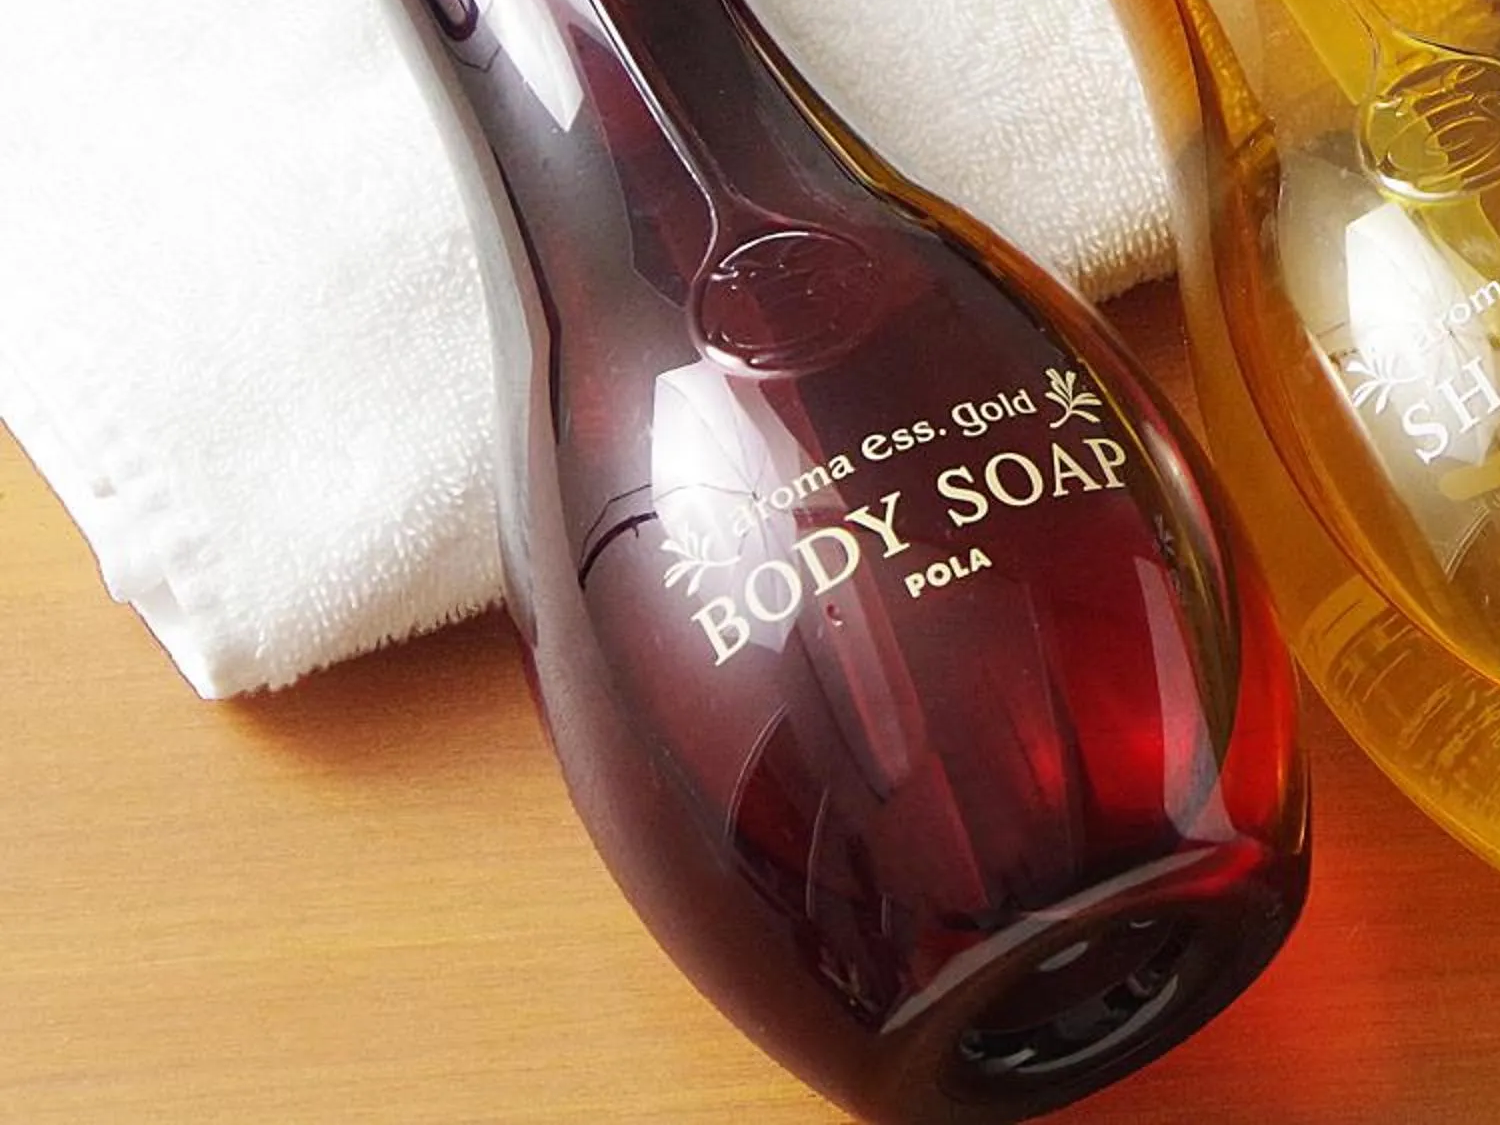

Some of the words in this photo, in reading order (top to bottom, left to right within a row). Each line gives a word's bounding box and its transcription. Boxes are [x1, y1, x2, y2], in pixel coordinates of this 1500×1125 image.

[731, 455, 855, 537] aroma
[861, 422, 947, 462] ess.
[951, 388, 1037, 436] gold
[691, 491, 910, 666] BODY
[936, 437, 1129, 528] SOAP
[904, 547, 993, 598] POLA
